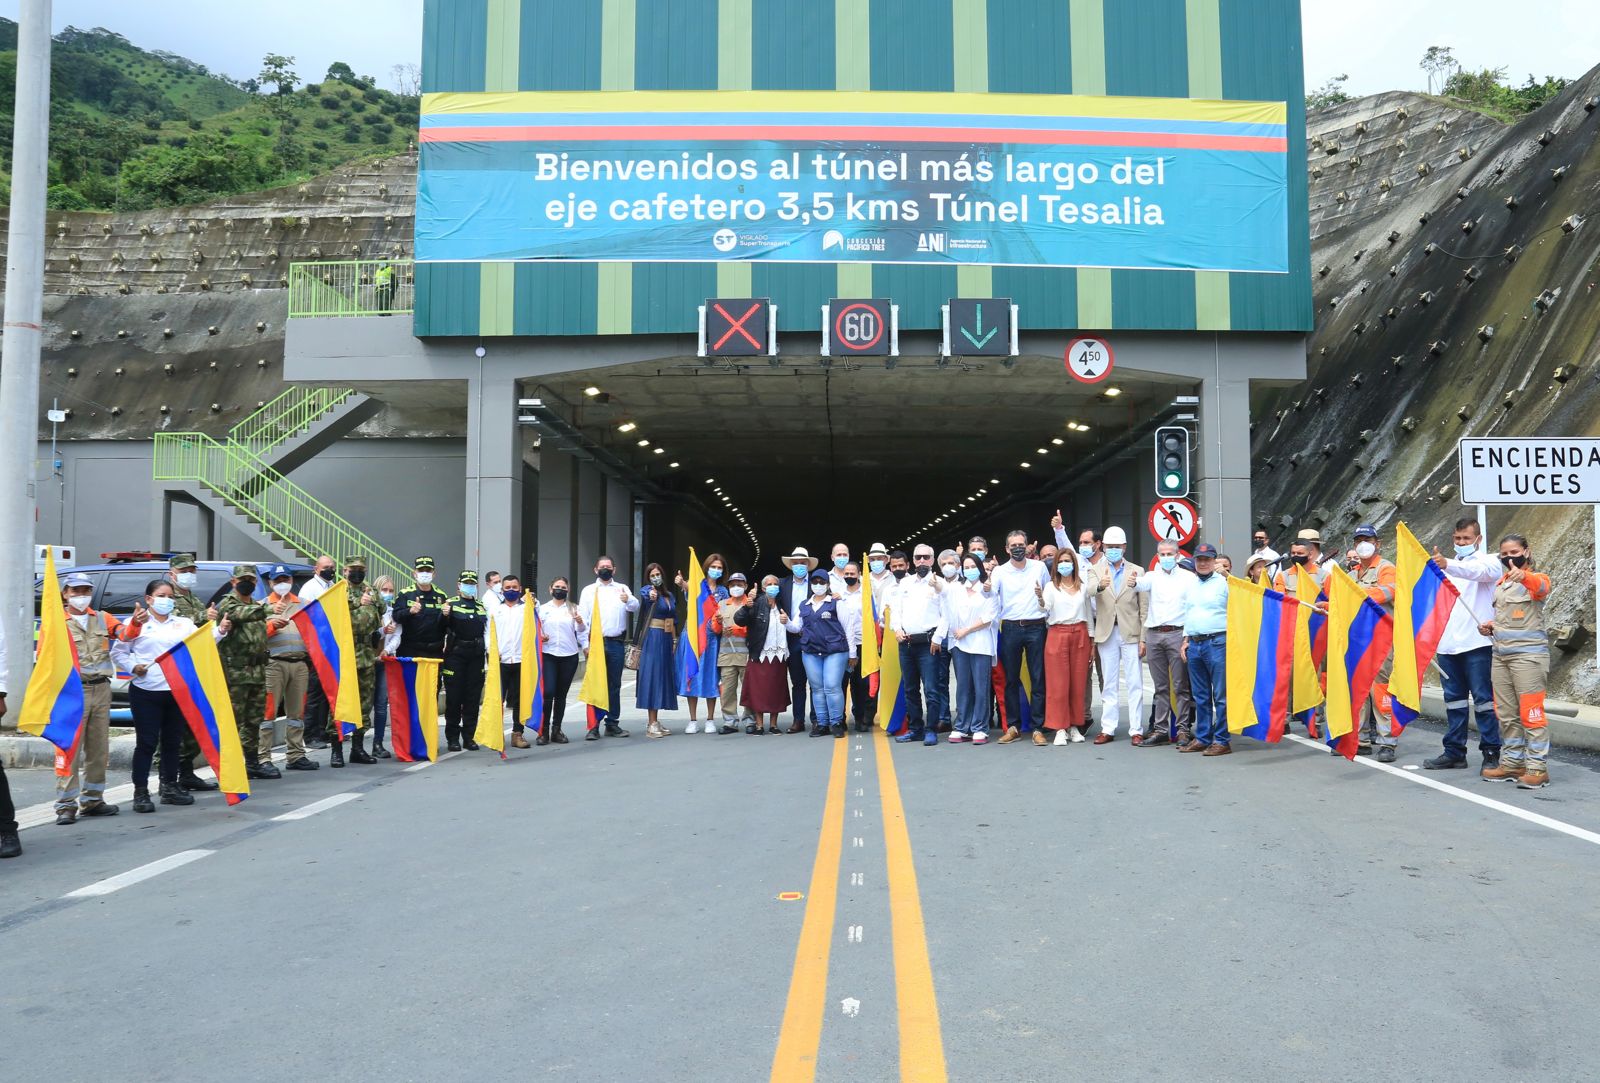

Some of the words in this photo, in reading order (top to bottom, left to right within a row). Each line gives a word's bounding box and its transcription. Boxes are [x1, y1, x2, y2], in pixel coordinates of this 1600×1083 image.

[534, 152, 758, 181] Bienvenidos
[769, 152, 800, 180] al
[812, 152, 907, 181] túnel
[921, 153, 994, 182] más
[1006, 154, 1099, 191] largo
[1110, 157, 1165, 185] del
[545, 192, 598, 228] eje
[609, 192, 766, 221] cafetero
[777, 192, 835, 225] 3,5
[846, 192, 920, 222] kms
[929, 193, 1028, 223] Túnel
[1039, 194, 1165, 226] Tesalia
[845, 312, 874, 341] 60
[1471, 446, 1600, 468] ENCIENDA
[1498, 473, 1581, 495] LUCES
